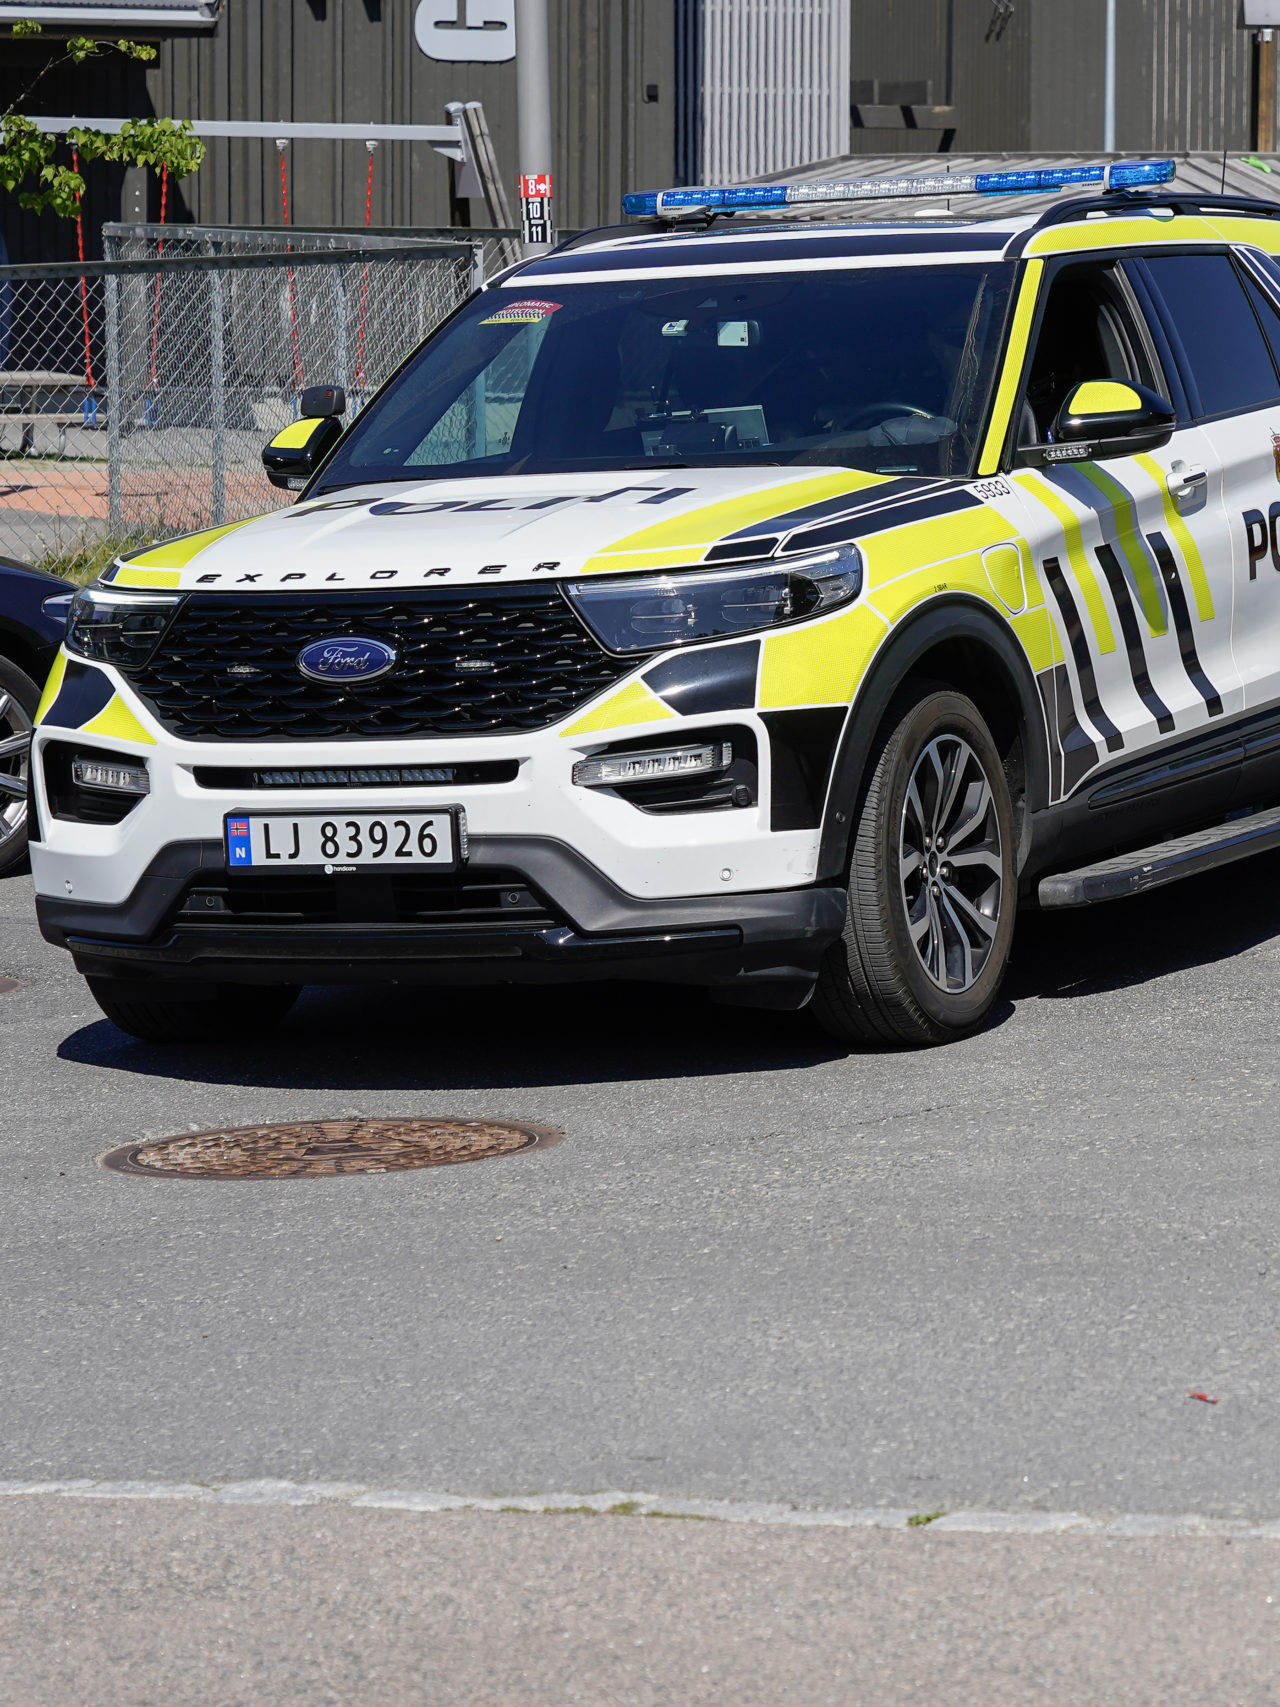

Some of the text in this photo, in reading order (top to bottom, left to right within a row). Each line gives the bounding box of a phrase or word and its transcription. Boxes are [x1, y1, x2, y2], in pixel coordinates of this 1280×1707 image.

[528, 179, 536, 195] 8
[528, 202, 541, 218] 10
[531, 225, 542, 241] 11
[973, 480, 1011, 500] 5933
[283, 487, 699, 518] POLITI
[195, 561, 562, 584] EXPLORER
[318, 646, 371, 670] Ford
[263, 819, 438, 860] LJ 83926
[235, 847, 246, 858] N
